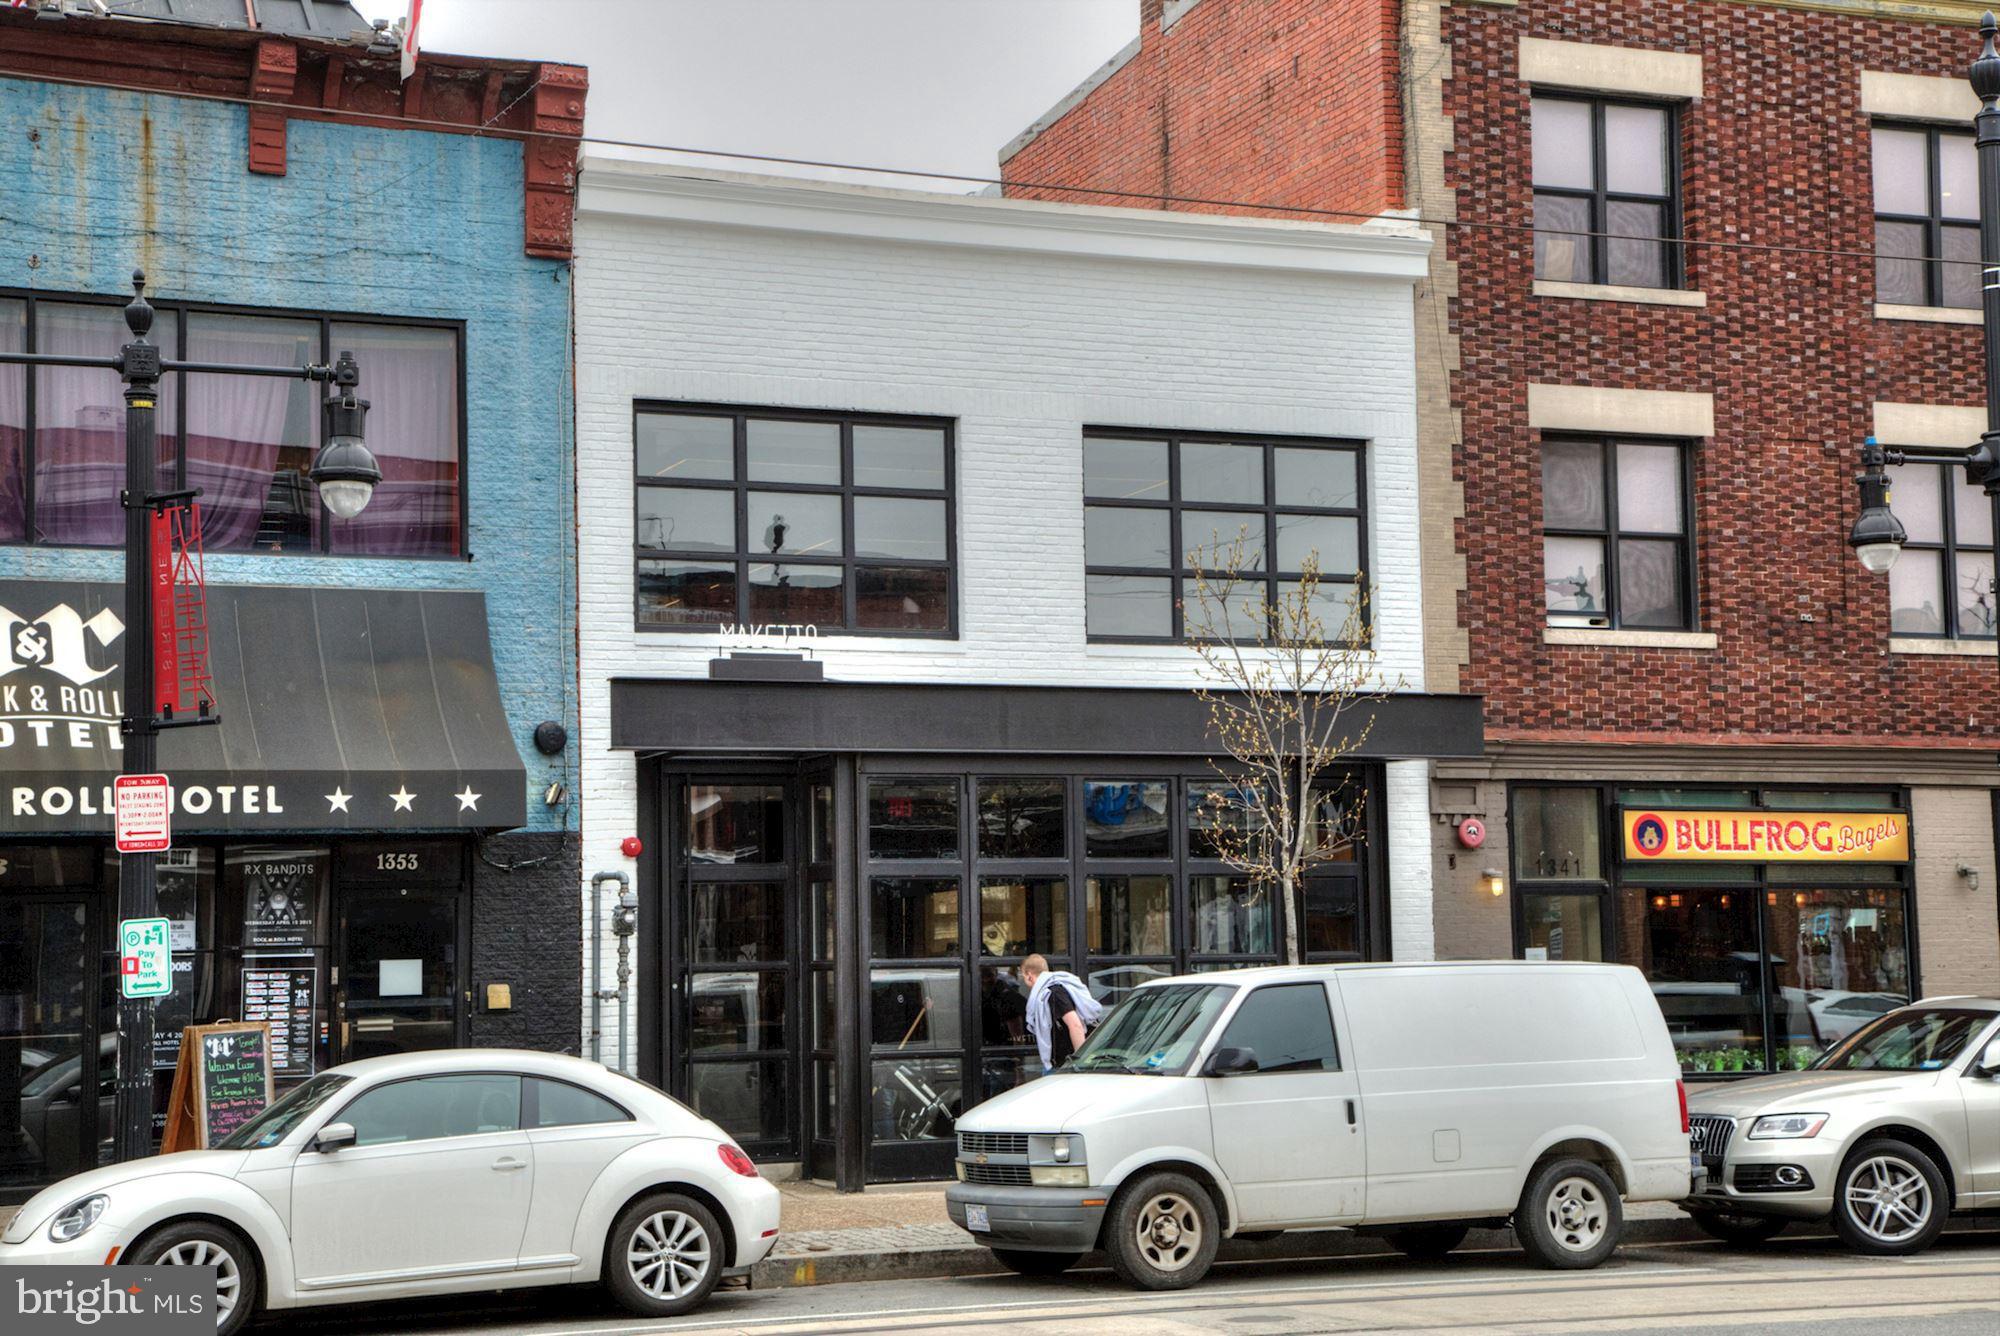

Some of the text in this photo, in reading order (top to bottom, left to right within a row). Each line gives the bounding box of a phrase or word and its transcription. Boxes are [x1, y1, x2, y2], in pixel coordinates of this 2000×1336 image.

[30, 685, 48, 712] &
[60, 685, 125, 717] ROLL
[12, 785, 284, 816] ROLL OTEL
[121, 791, 163, 801] NO PARKING
[1675, 816, 1902, 854] BULLFROG Bagels
[376, 853, 419, 870] 1353
[1535, 858, 1580, 877] 1341
[244, 863, 314, 876] RX BANDITS
[138, 950, 155, 958] Pay
[142, 961, 153, 969] To
[137, 971, 158, 979] Park
